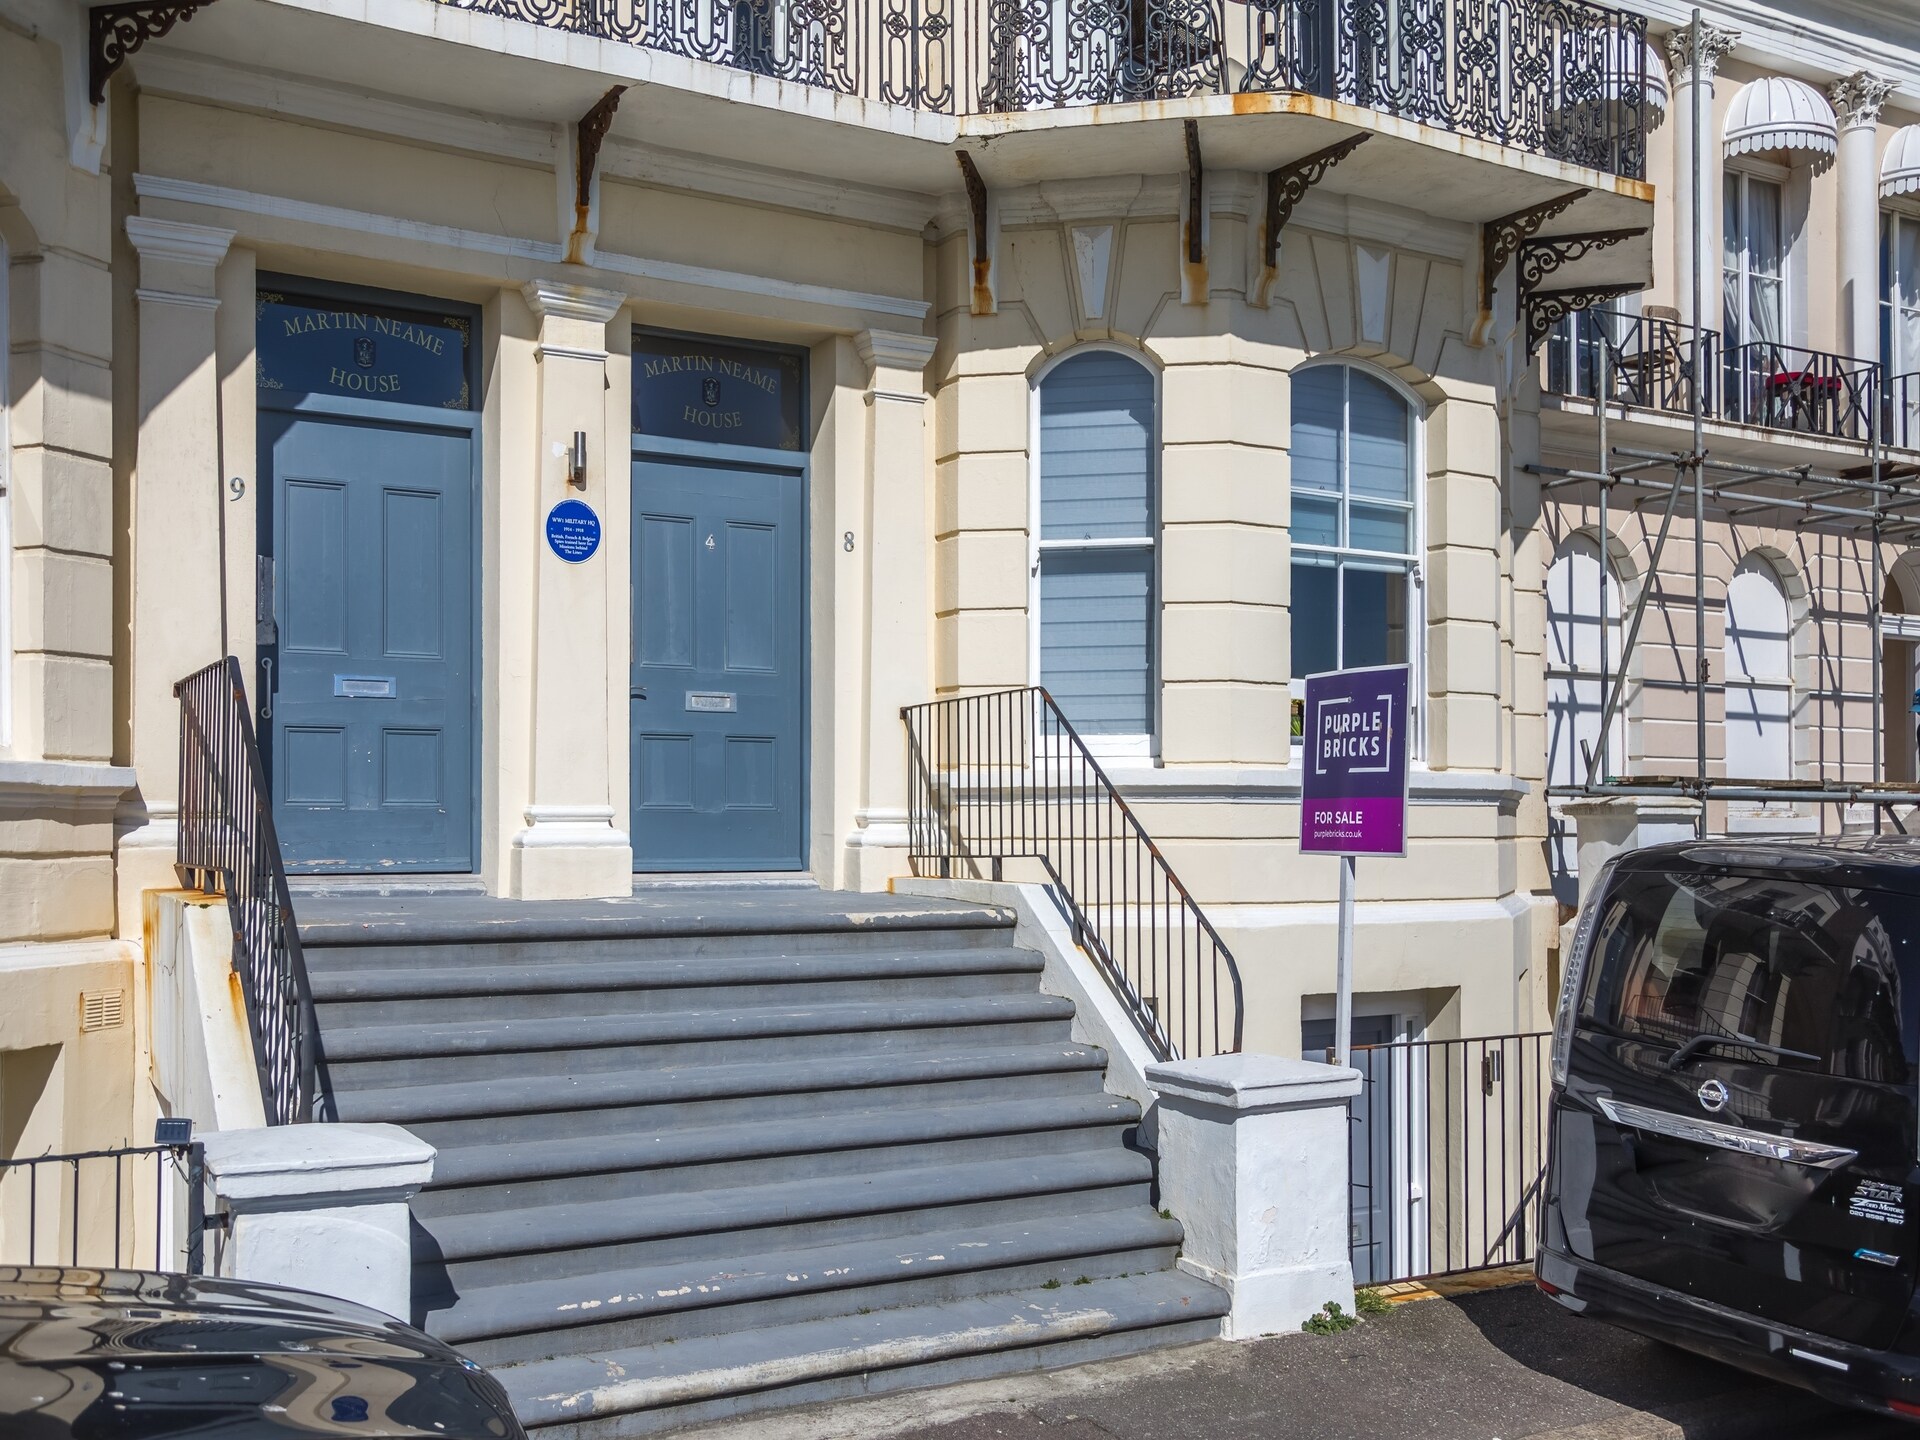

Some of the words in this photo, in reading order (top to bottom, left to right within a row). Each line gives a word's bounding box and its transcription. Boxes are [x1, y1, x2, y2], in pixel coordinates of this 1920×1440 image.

[283, 311, 368, 337] MARTIN
[373, 315, 445, 356] NEAME
[329, 367, 401, 393] HOUSE
[643, 355, 714, 378] MARTIN
[719, 358, 777, 395] NEAME
[682, 405, 742, 429] HOUSE
[229, 477, 246, 502] 9
[705, 534, 716, 550] 4
[844, 531, 855, 552] 8
[1324, 711, 1381, 735] PURPLE
[1323, 736, 1380, 759] BRICKS
[1314, 811, 1333, 825] FOR
[1335, 811, 1363, 825] SALE
[1313, 829, 1363, 839] purplebricks.co.uk
[1855, 1186, 1902, 1203] STAR
[1849, 1209, 1864, 1217] 020
